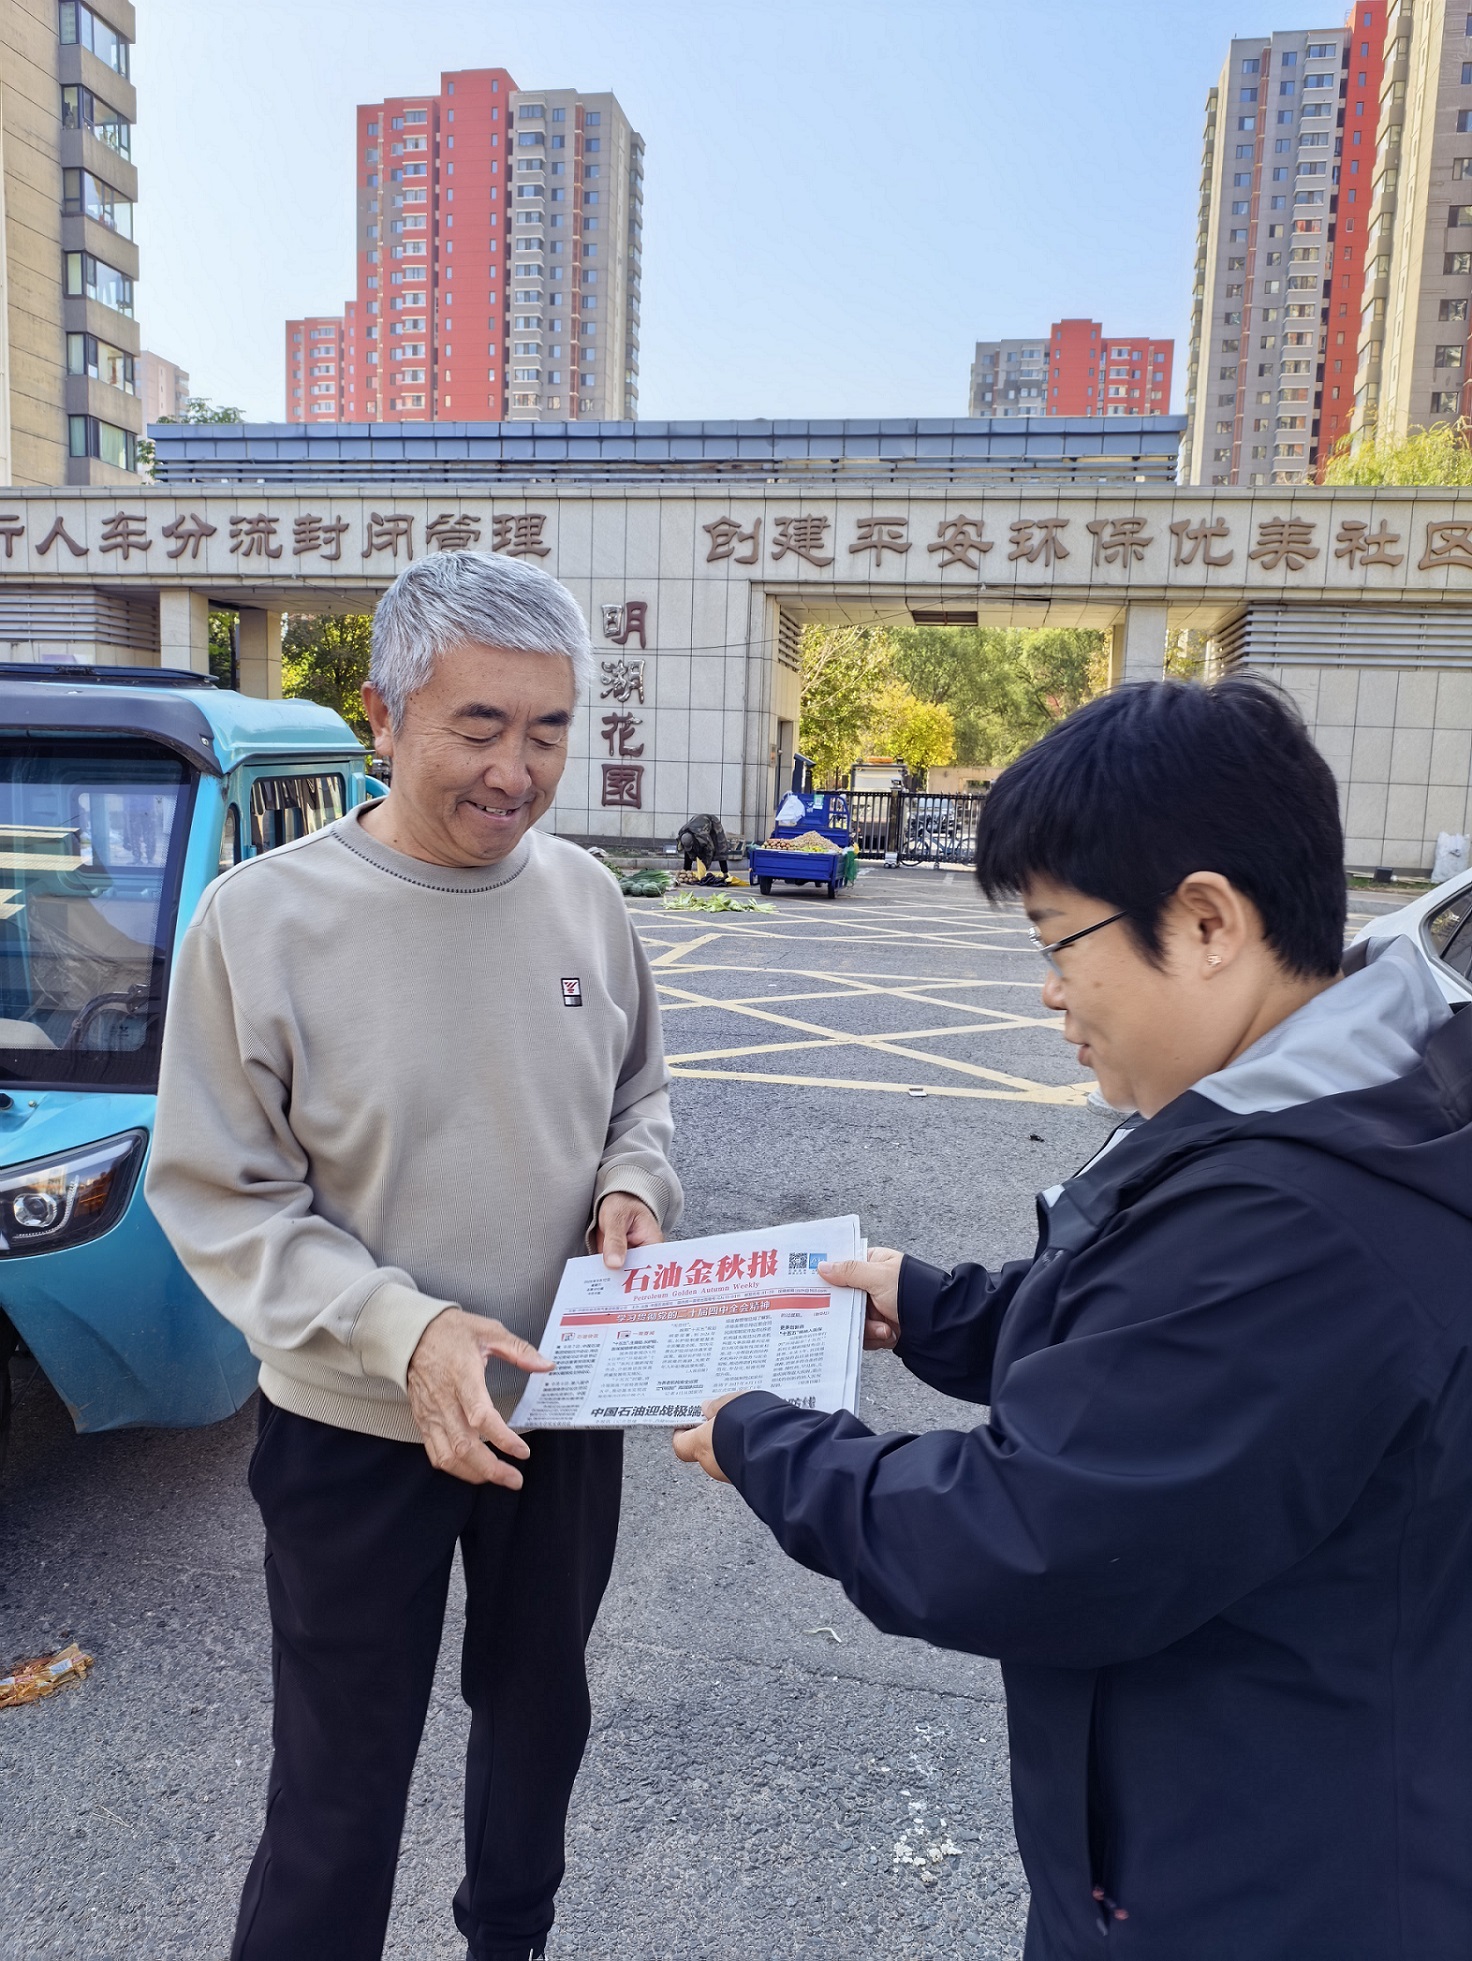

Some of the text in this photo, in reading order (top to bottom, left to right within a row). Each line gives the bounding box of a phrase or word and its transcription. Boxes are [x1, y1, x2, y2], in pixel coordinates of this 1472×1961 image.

[702, 513, 1472, 571] 创建平安环保优美社区
[621, 1248, 779, 1294] 石油金秋报
[633, 1281, 760, 1302] Petroleum Golden Autumn Weekly
[590, 1404, 704, 1418] 中国石油迎战极端
